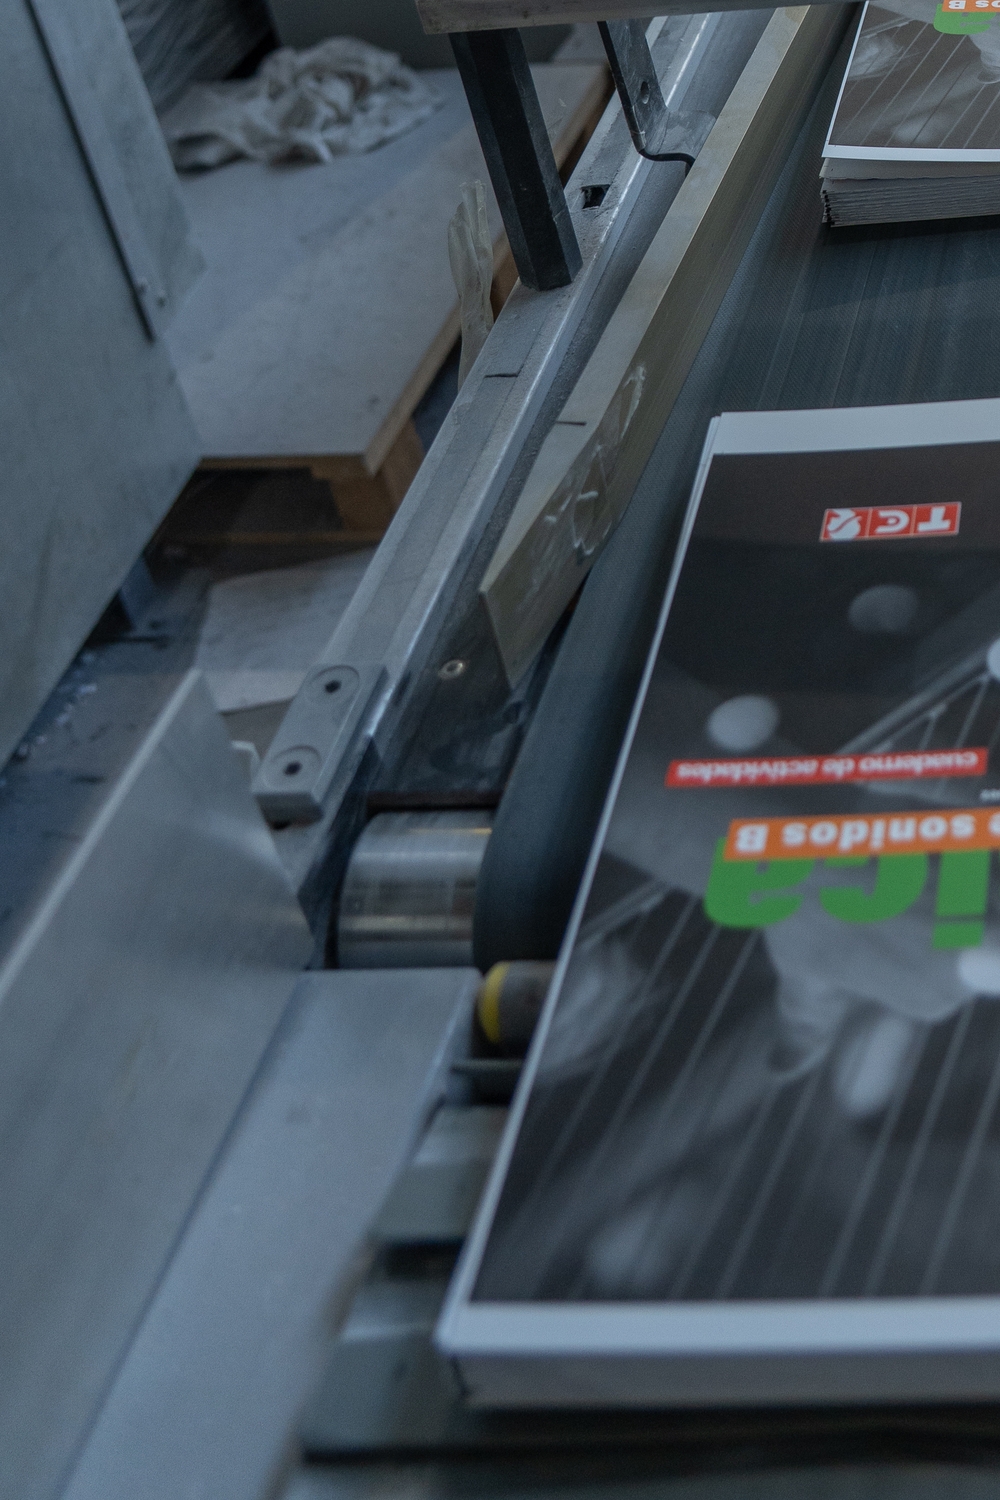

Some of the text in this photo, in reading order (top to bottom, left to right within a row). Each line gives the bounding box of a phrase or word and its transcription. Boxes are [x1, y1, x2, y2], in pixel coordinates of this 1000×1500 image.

[949, 0, 966, 10] B
[676, 750, 979, 783] cuaderno de actividades
[733, 823, 770, 854] B
[780, 813, 977, 852] sonidos
